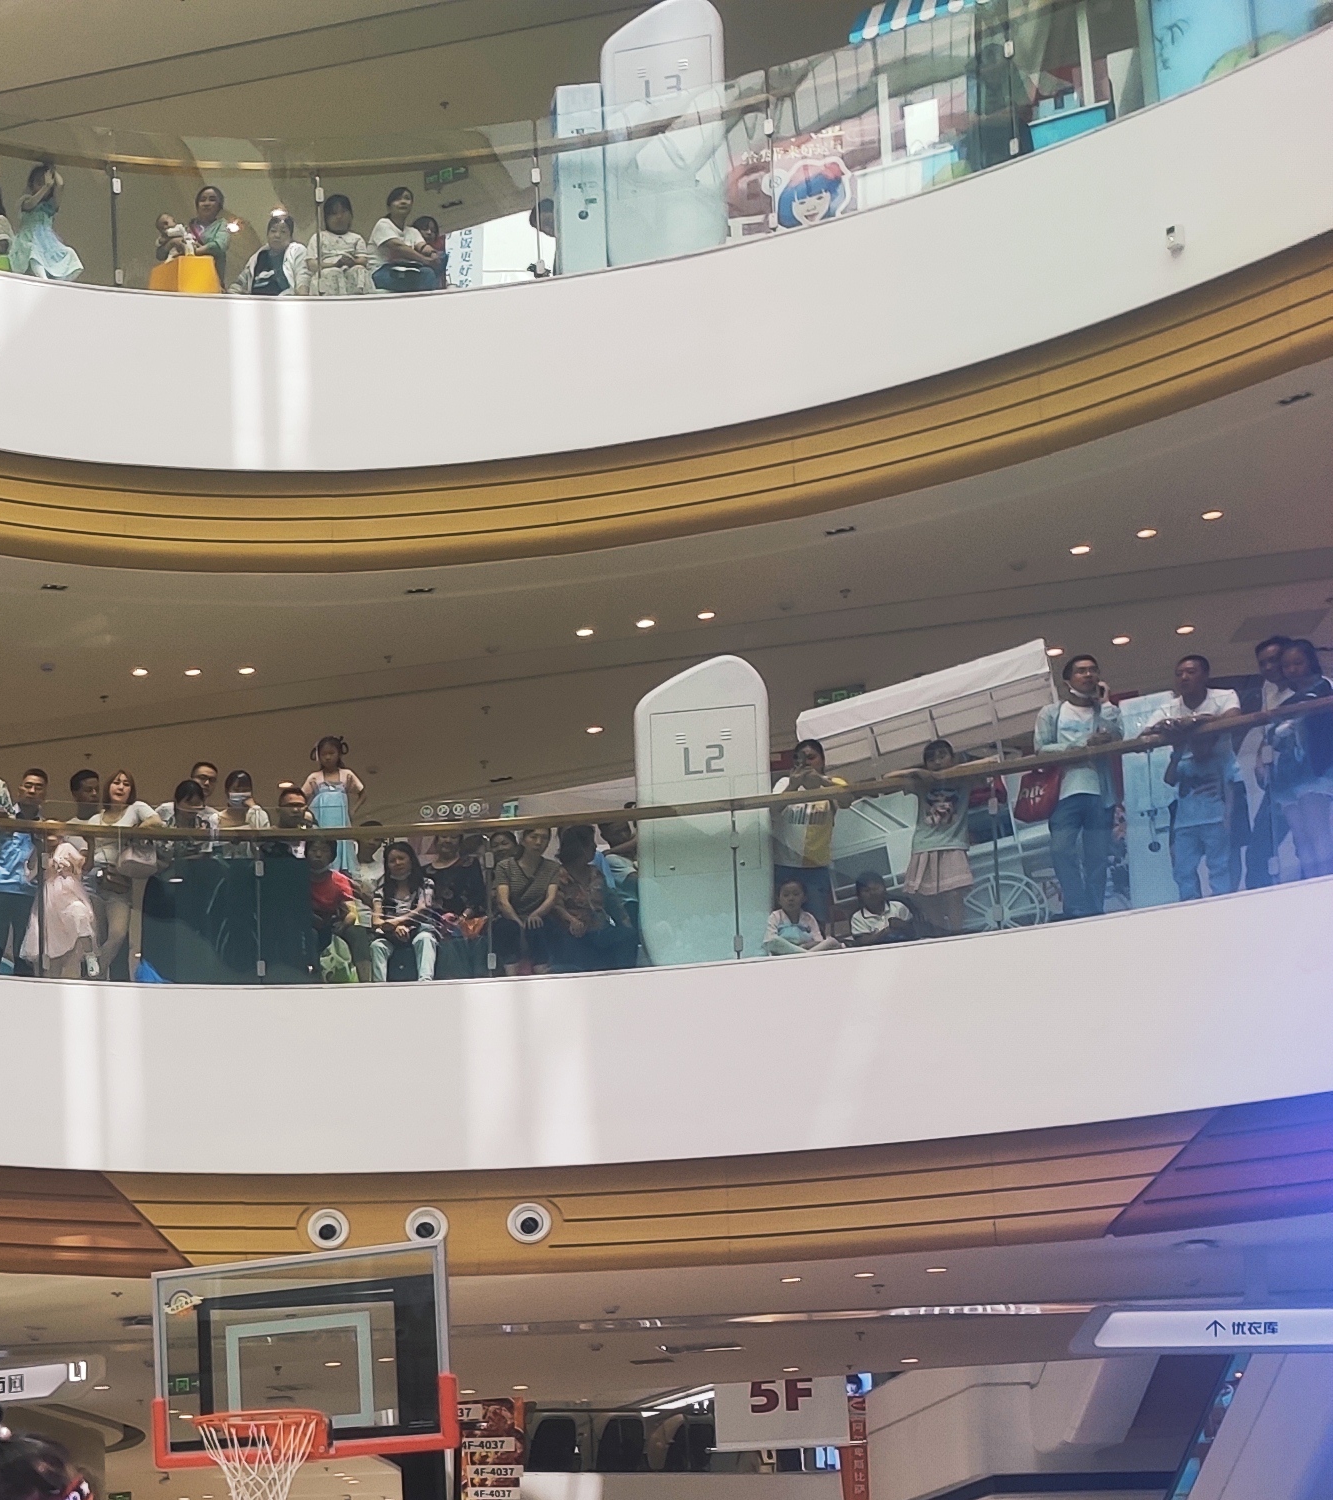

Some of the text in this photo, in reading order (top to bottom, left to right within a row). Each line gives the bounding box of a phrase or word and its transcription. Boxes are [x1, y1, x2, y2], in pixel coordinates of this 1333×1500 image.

[683, 744, 725, 775] L2
[1232, 1321, 1278, 1335] 优衣库
[68, 1360, 87, 1382] L1
[749, 1377, 813, 1414] 5F
[462, 1440, 506, 1450] 4F-4037
[473, 1467, 515, 1477] 4F-4037
[473, 1489, 512, 1498] 4F-4037
